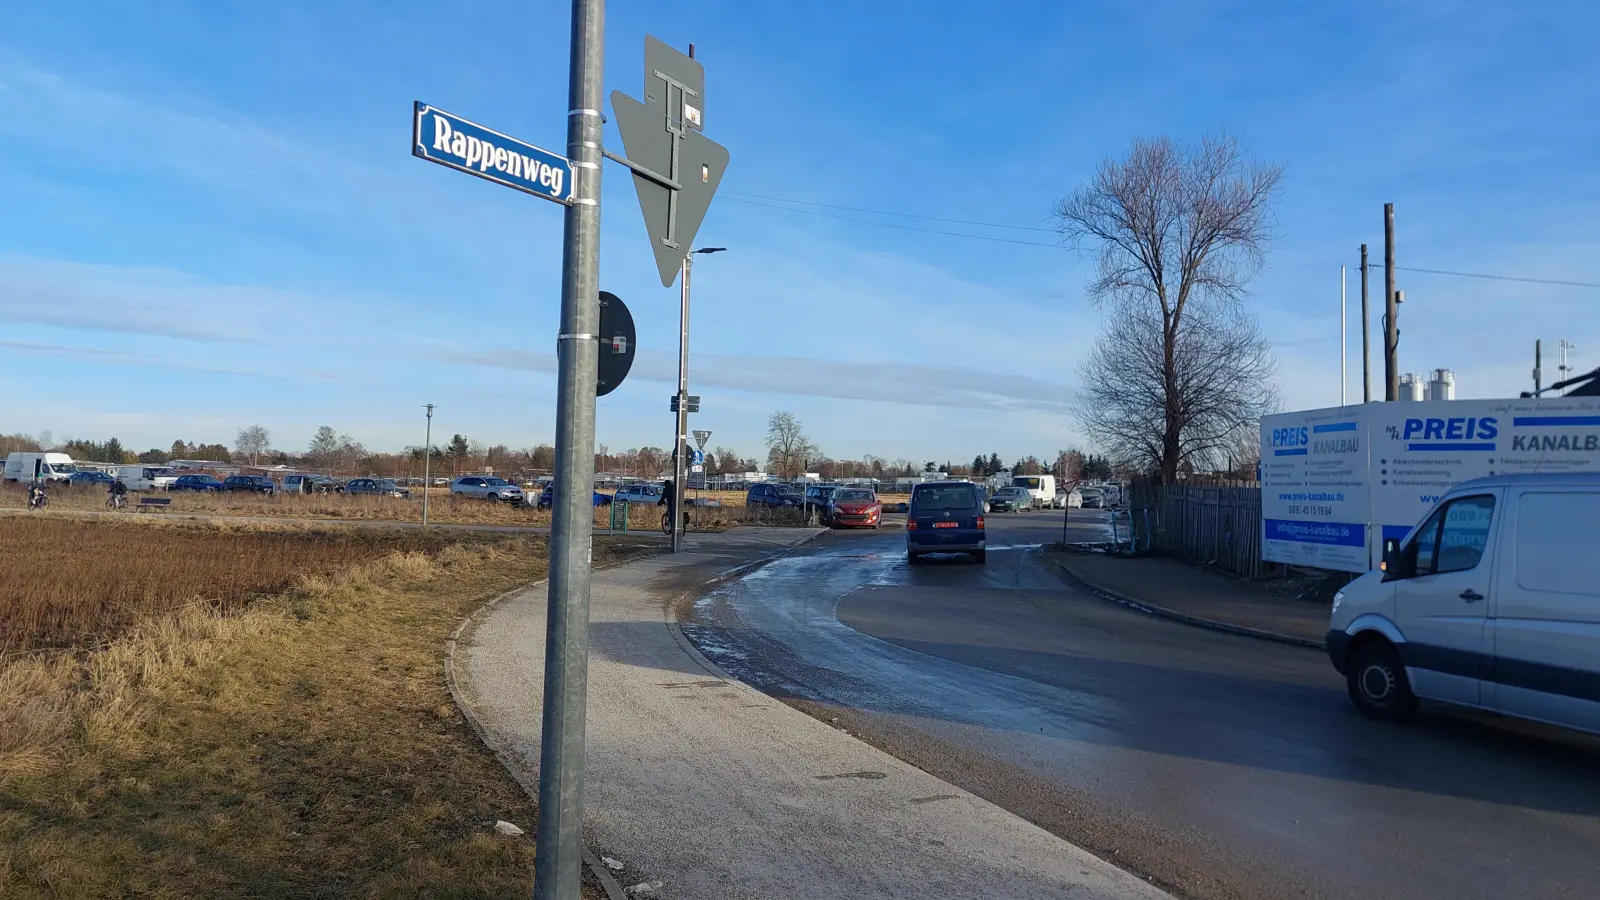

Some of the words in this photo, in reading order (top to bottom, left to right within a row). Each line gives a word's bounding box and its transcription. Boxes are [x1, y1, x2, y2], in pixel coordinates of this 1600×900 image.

[432, 113, 564, 197] Rappenweg
[1272, 426, 1309, 447] PREIS
[1403, 417, 1498, 440] PREIS
[1313, 437, 1360, 455] KANALBAU
[1512, 435, 1600, 451] KANALB
[1279, 491, 1344, 502] www.preis-kanalbau.de
